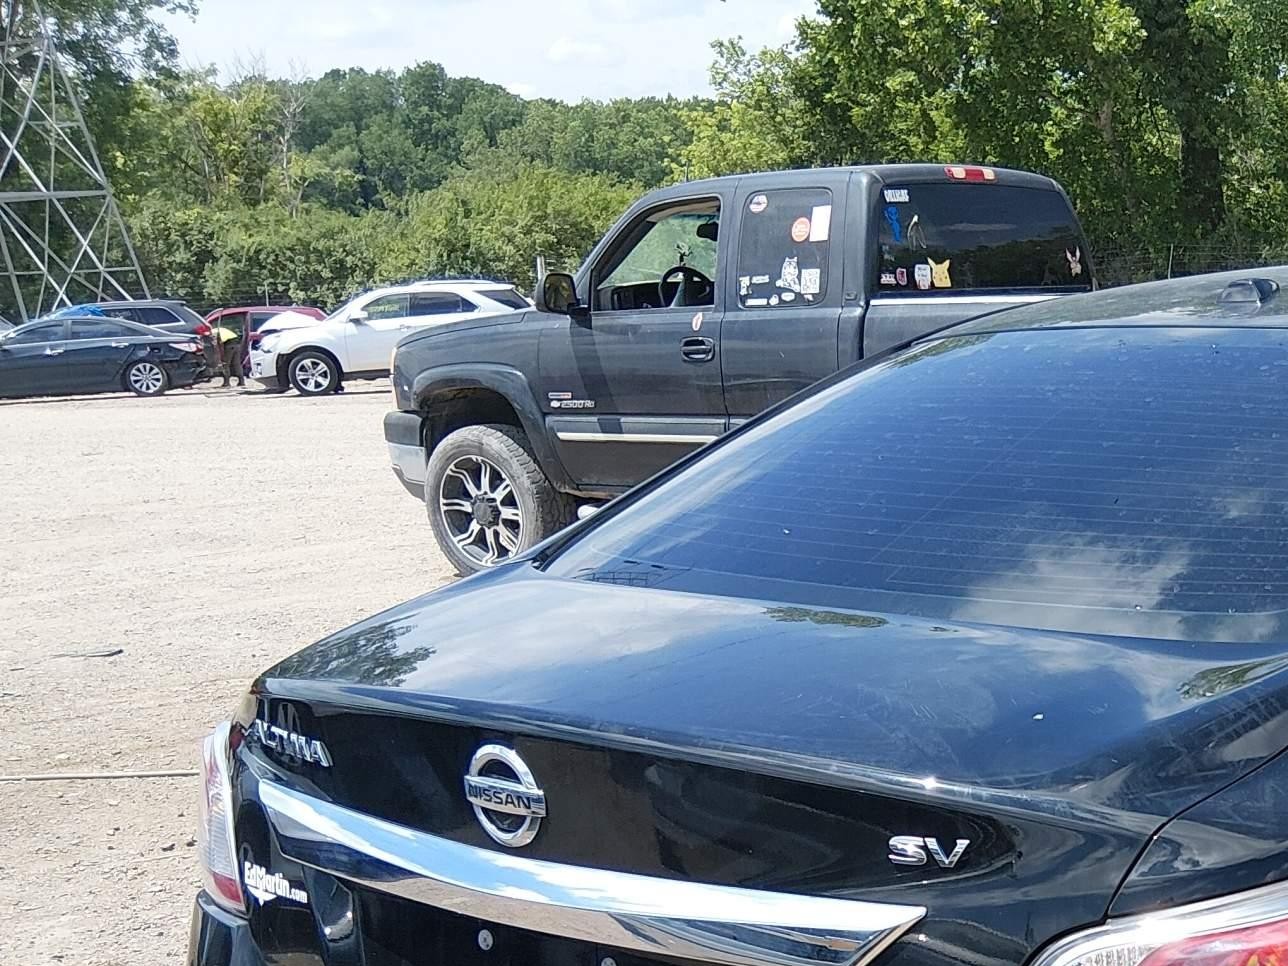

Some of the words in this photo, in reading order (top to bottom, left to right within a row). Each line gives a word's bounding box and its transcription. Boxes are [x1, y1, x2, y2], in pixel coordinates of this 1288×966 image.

[468, 783, 532, 810] NISSAN
[887, 835, 971, 868] SV
[244, 861, 308, 904] EdMartin.com
